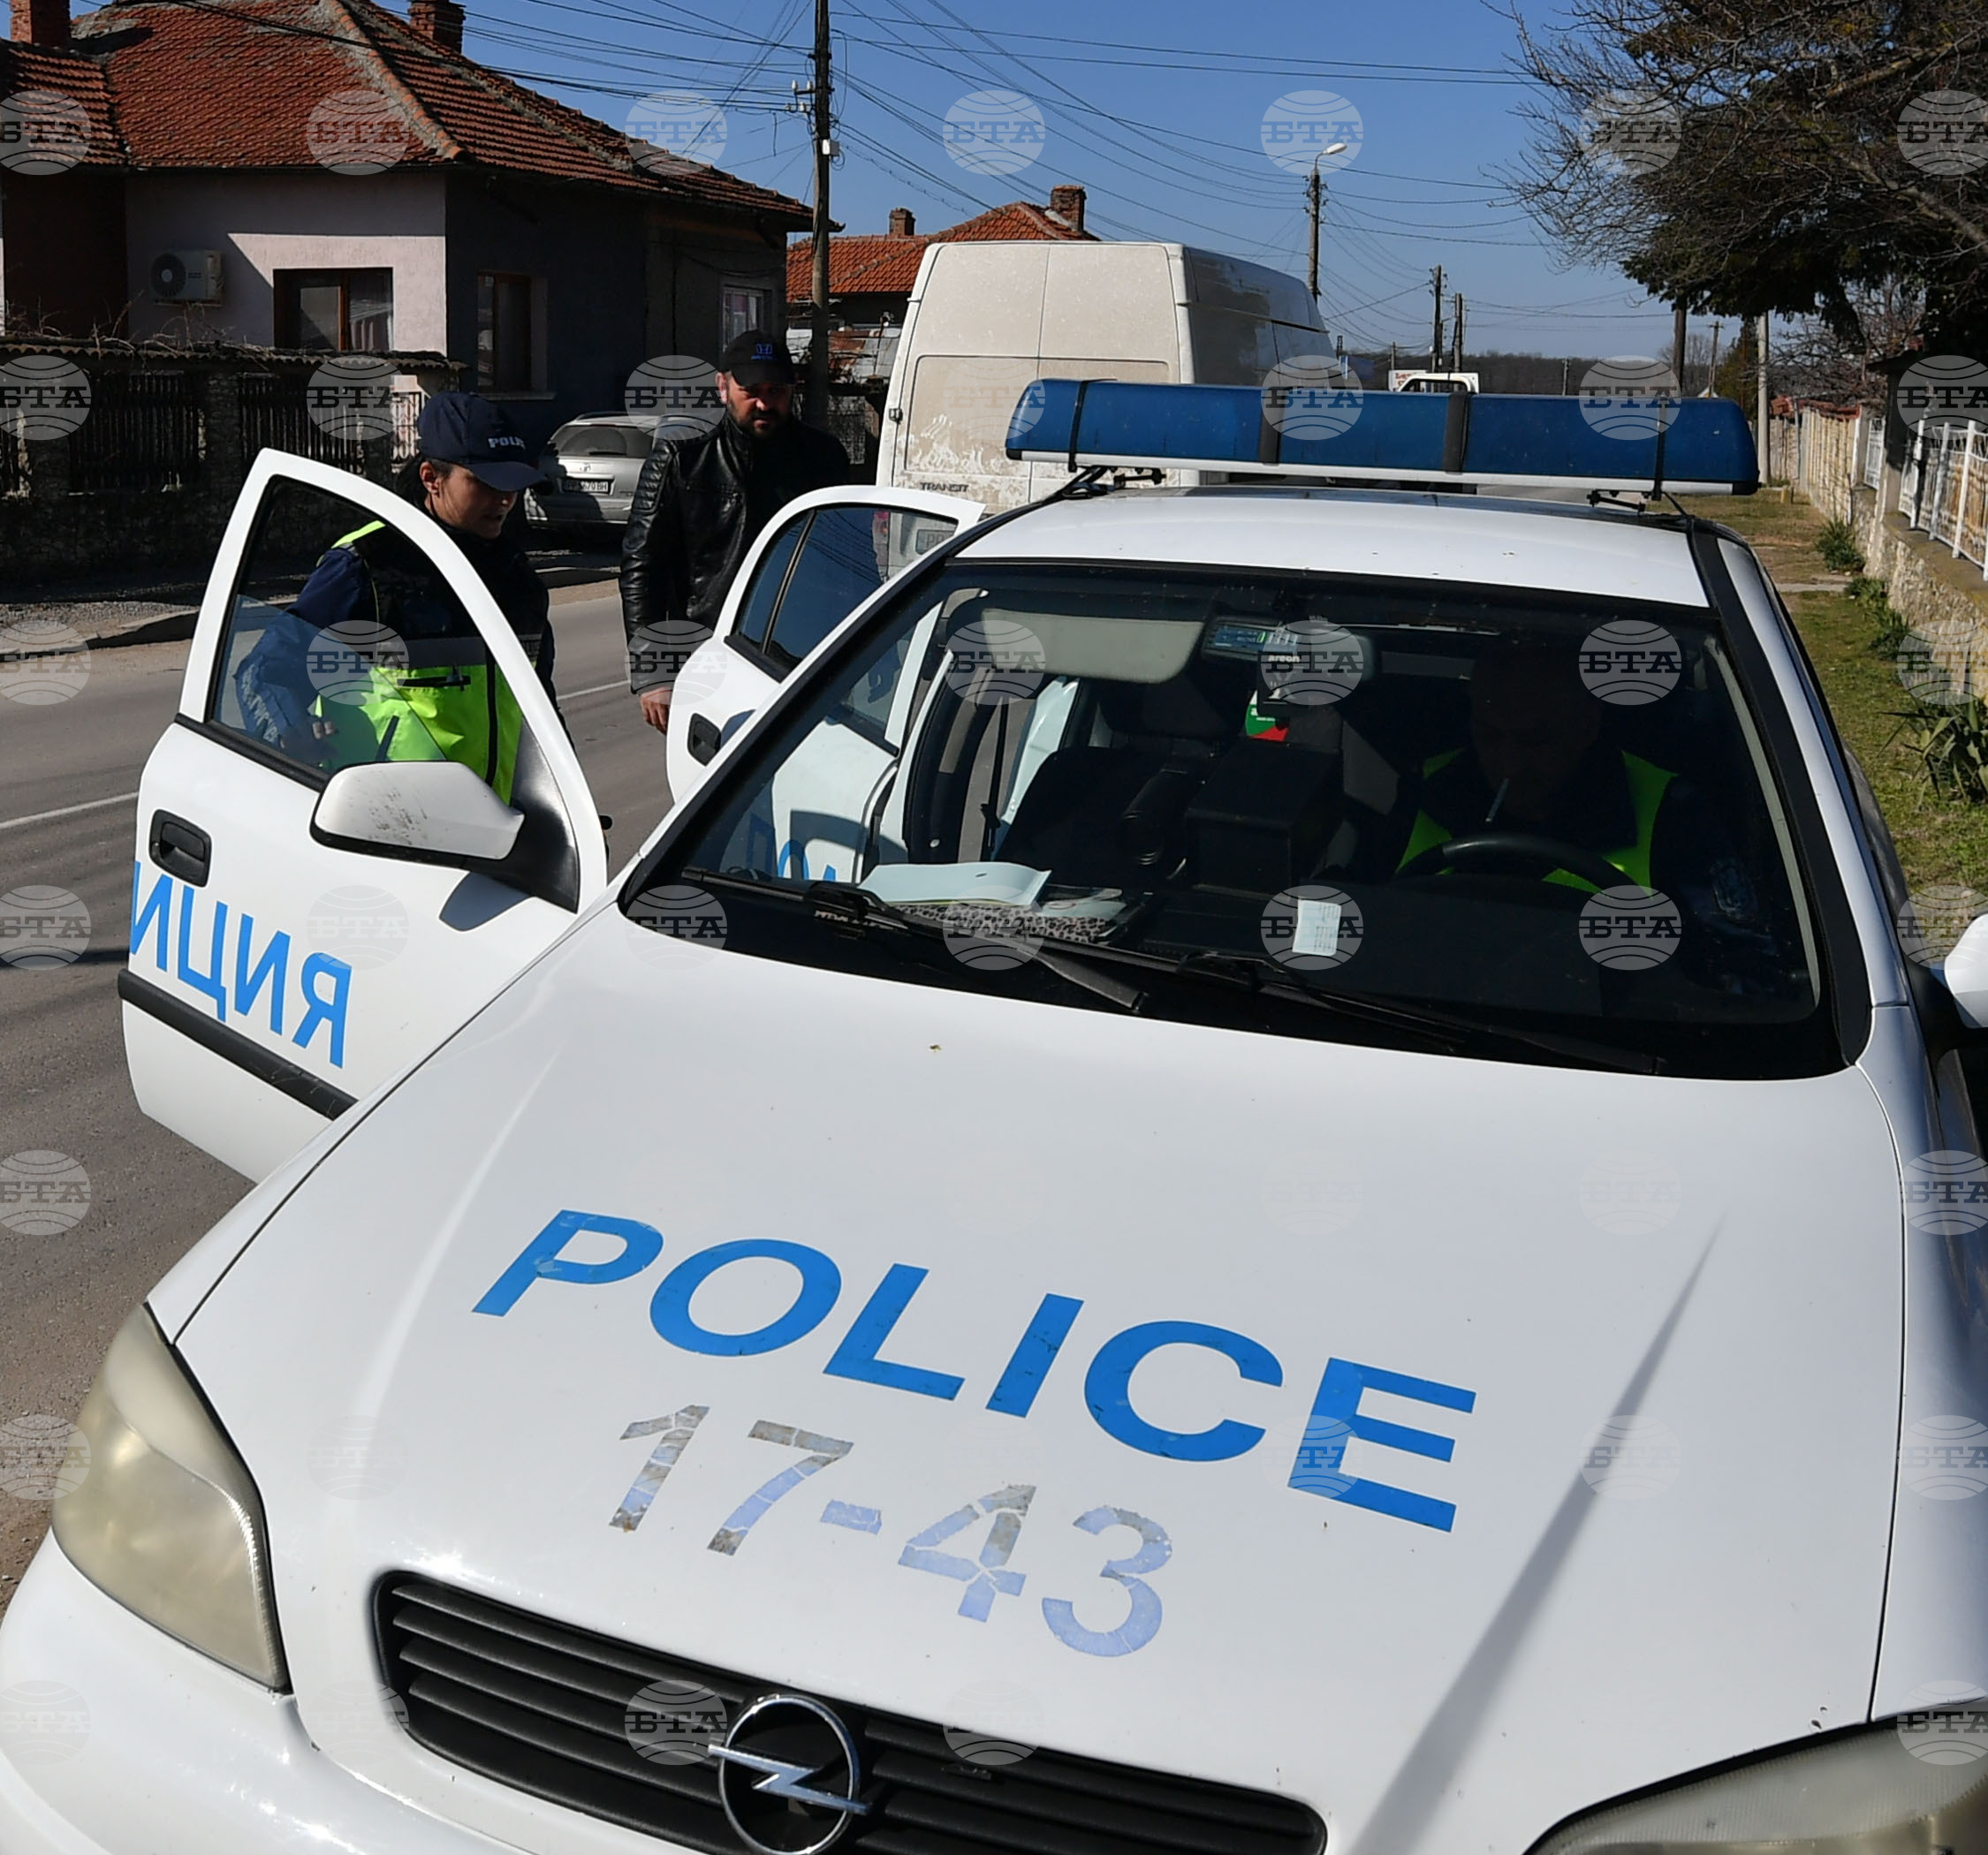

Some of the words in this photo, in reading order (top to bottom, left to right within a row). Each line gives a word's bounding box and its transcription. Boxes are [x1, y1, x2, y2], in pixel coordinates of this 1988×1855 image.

[920, 482, 968, 493] TRANSIT
[1268, 655, 1301, 663] areon
[474, 1209, 1476, 1533] POLICE
[609, 1404, 1172, 1657] 17-43
